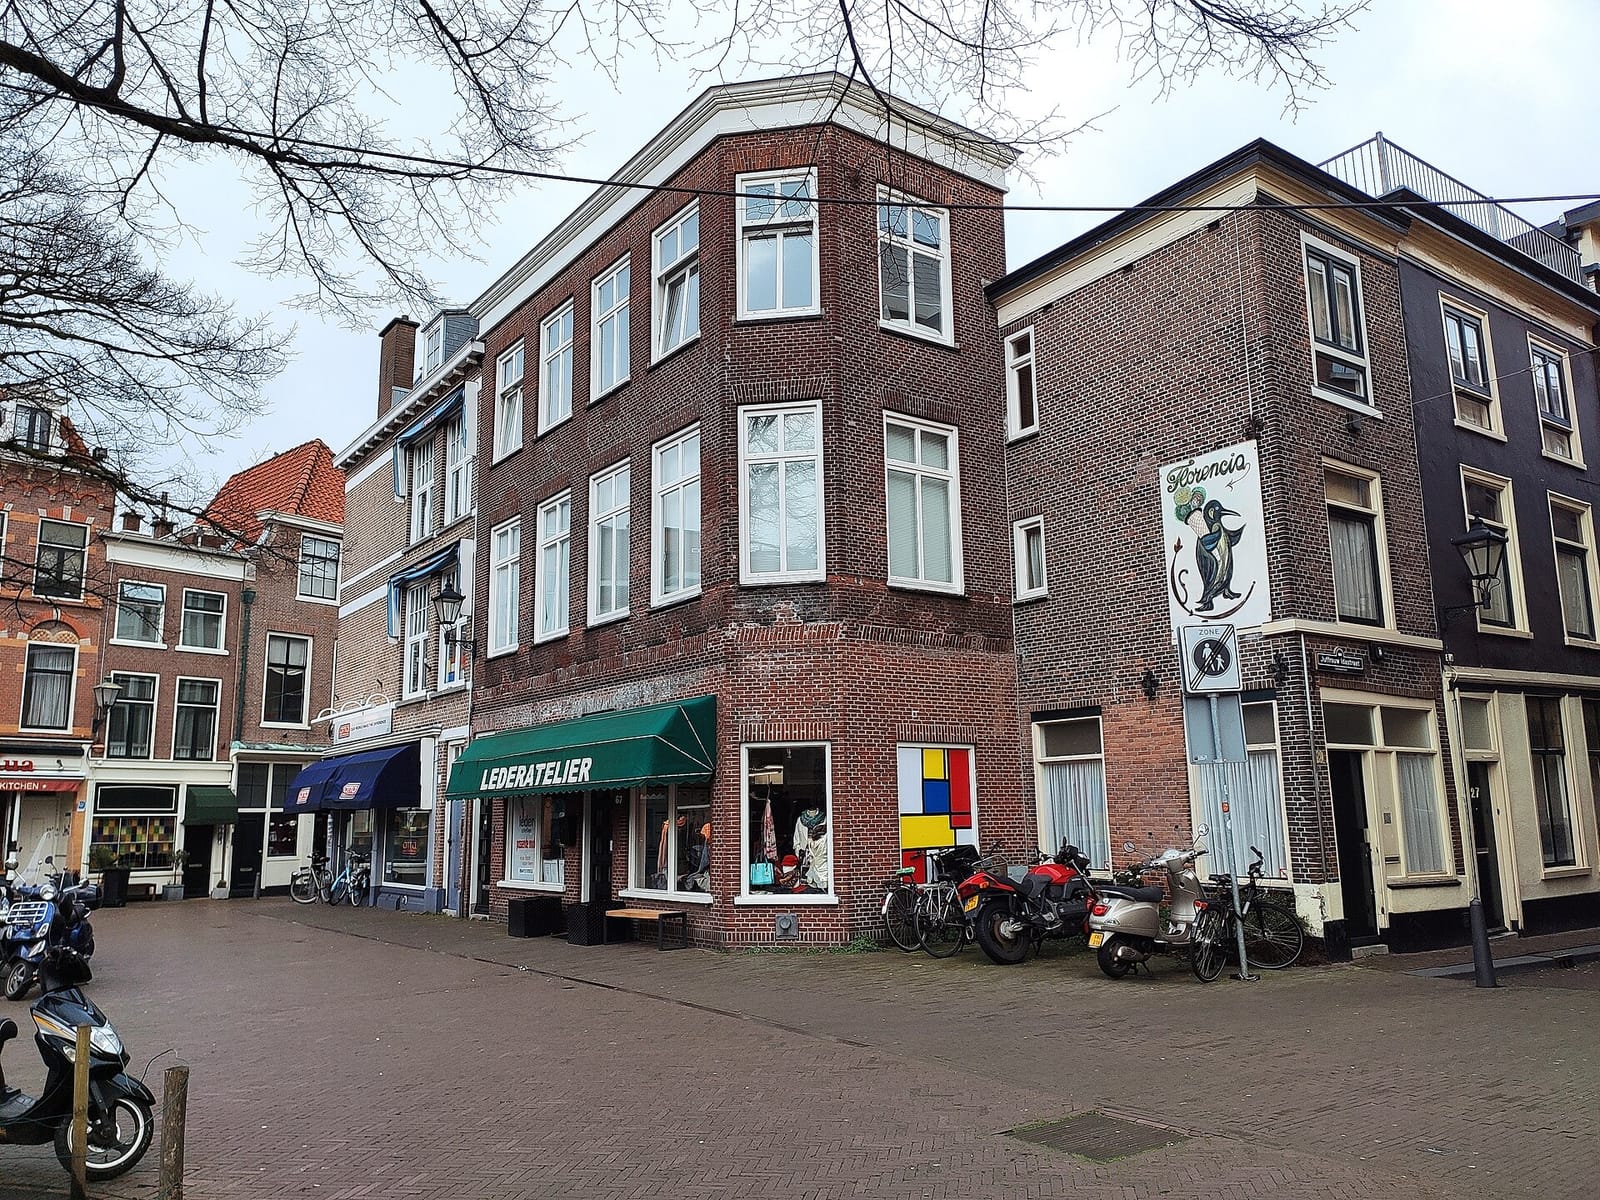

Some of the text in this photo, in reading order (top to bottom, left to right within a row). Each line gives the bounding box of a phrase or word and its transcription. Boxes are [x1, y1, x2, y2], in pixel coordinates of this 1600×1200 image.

[1166, 452, 1246, 493] Florencia
[479, 757, 593, 791] LEDERATELIER
[0, 782, 39, 790] KITCHEN
[1470, 786, 1480, 799] 27
